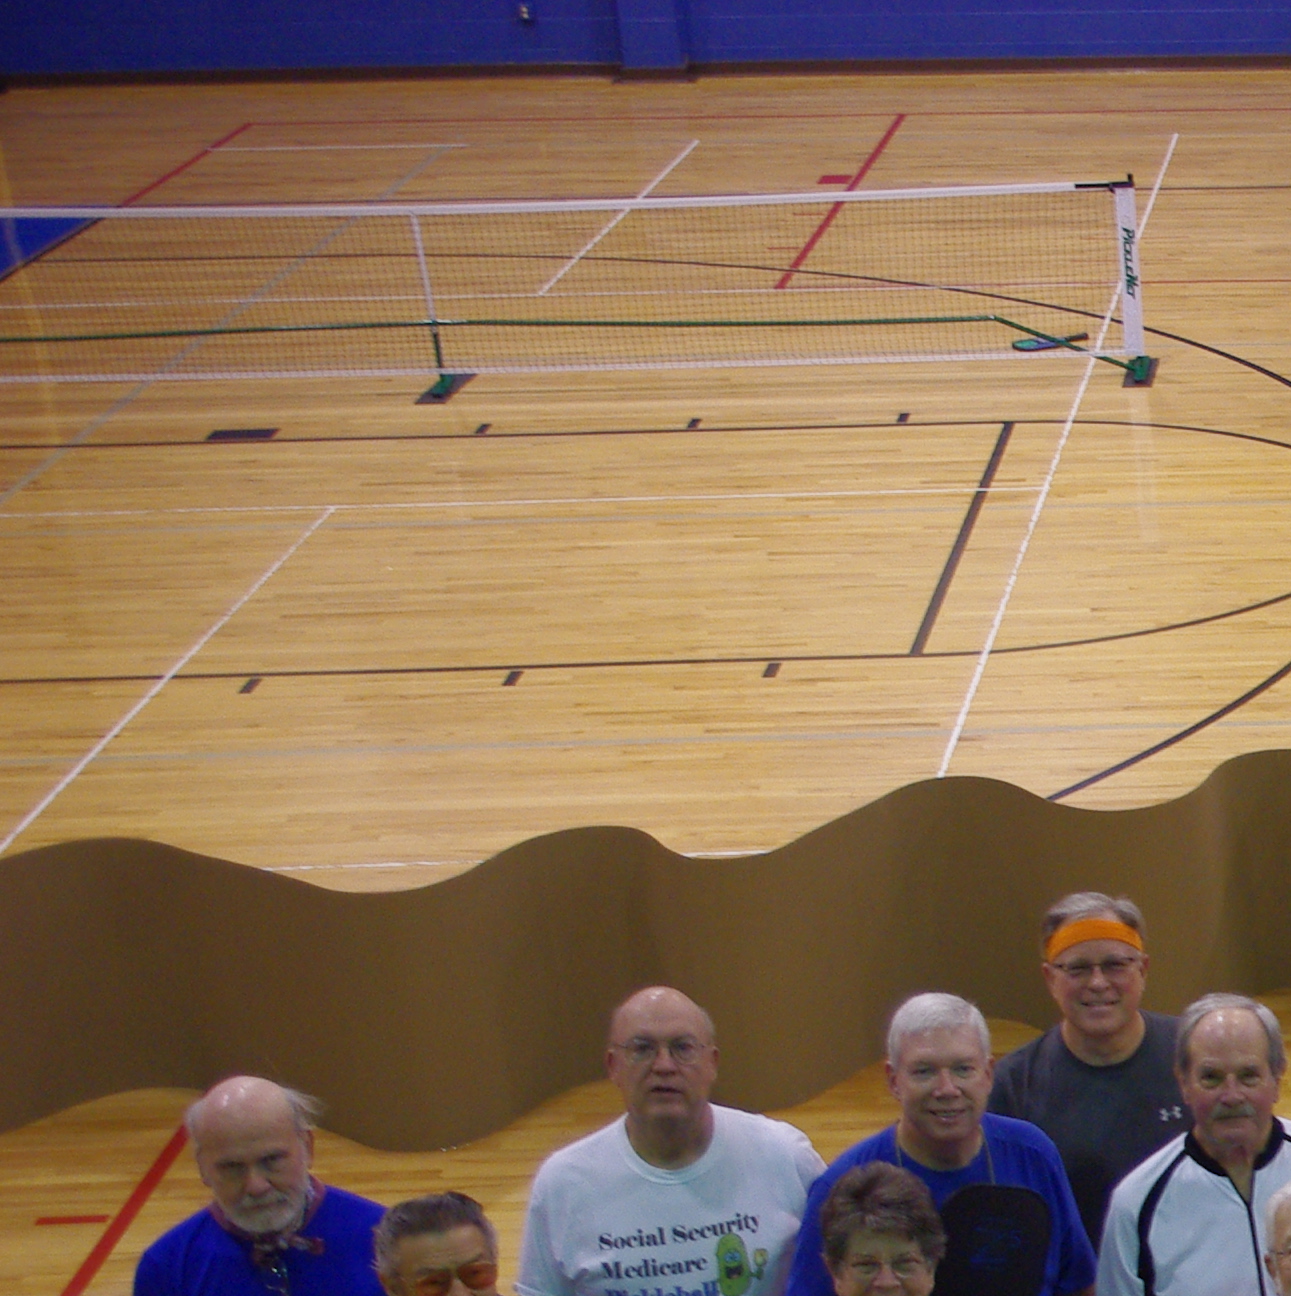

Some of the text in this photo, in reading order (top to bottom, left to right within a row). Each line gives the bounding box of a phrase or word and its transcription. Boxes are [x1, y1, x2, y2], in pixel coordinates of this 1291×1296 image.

[597, 1213, 760, 1251] Social Security
[601, 1255, 709, 1280] Medicare
